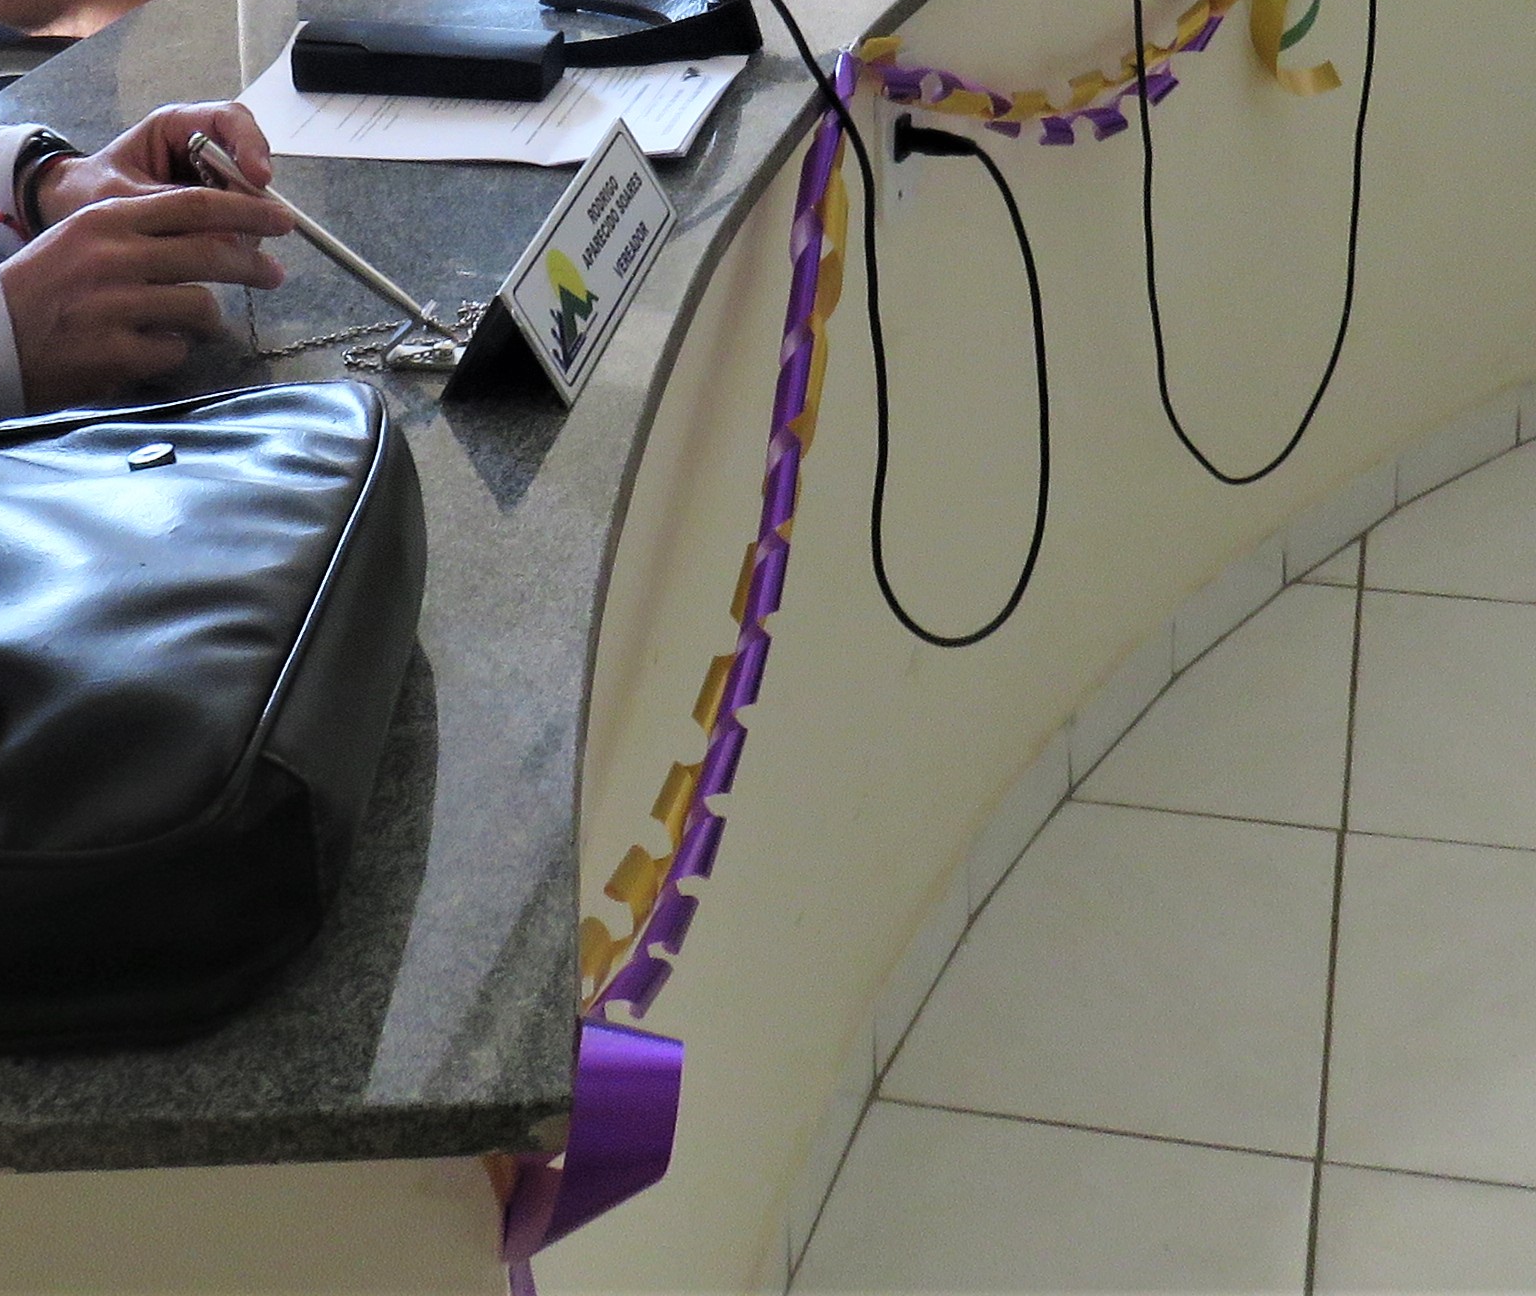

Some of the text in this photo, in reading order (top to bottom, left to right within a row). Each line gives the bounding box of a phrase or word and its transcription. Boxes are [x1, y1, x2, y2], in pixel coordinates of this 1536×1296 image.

[581, 171, 644, 271] APARECIDO SOARES
[586, 175, 619, 224] RODRIGO
[612, 221, 651, 279] VEREADOR
